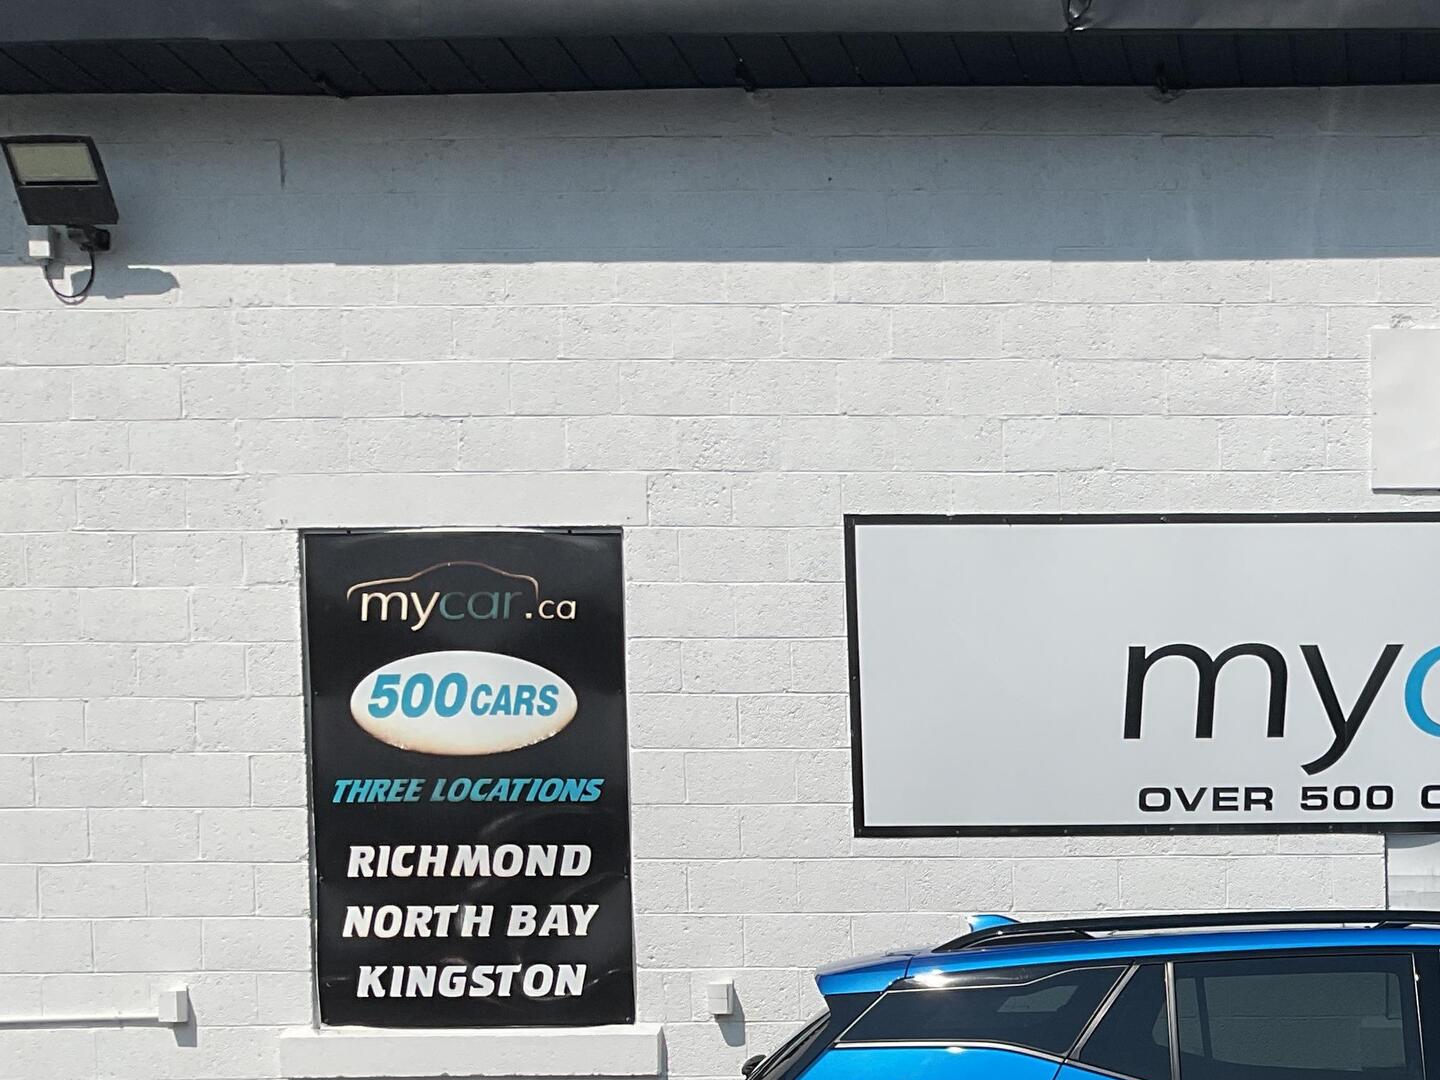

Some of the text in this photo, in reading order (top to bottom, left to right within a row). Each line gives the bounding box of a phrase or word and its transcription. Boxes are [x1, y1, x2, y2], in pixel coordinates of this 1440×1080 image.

[360, 588, 577, 632] mycar.ca
[367, 672, 560, 719] 500 CARS
[332, 777, 605, 804] THREE LOCATIONS
[1137, 785, 1274, 813] OVER
[1299, 785, 1394, 811] 500
[346, 844, 592, 879] RICHMOND
[341, 903, 601, 939] NORTH BAY
[355, 963, 588, 999] KINGSTON
